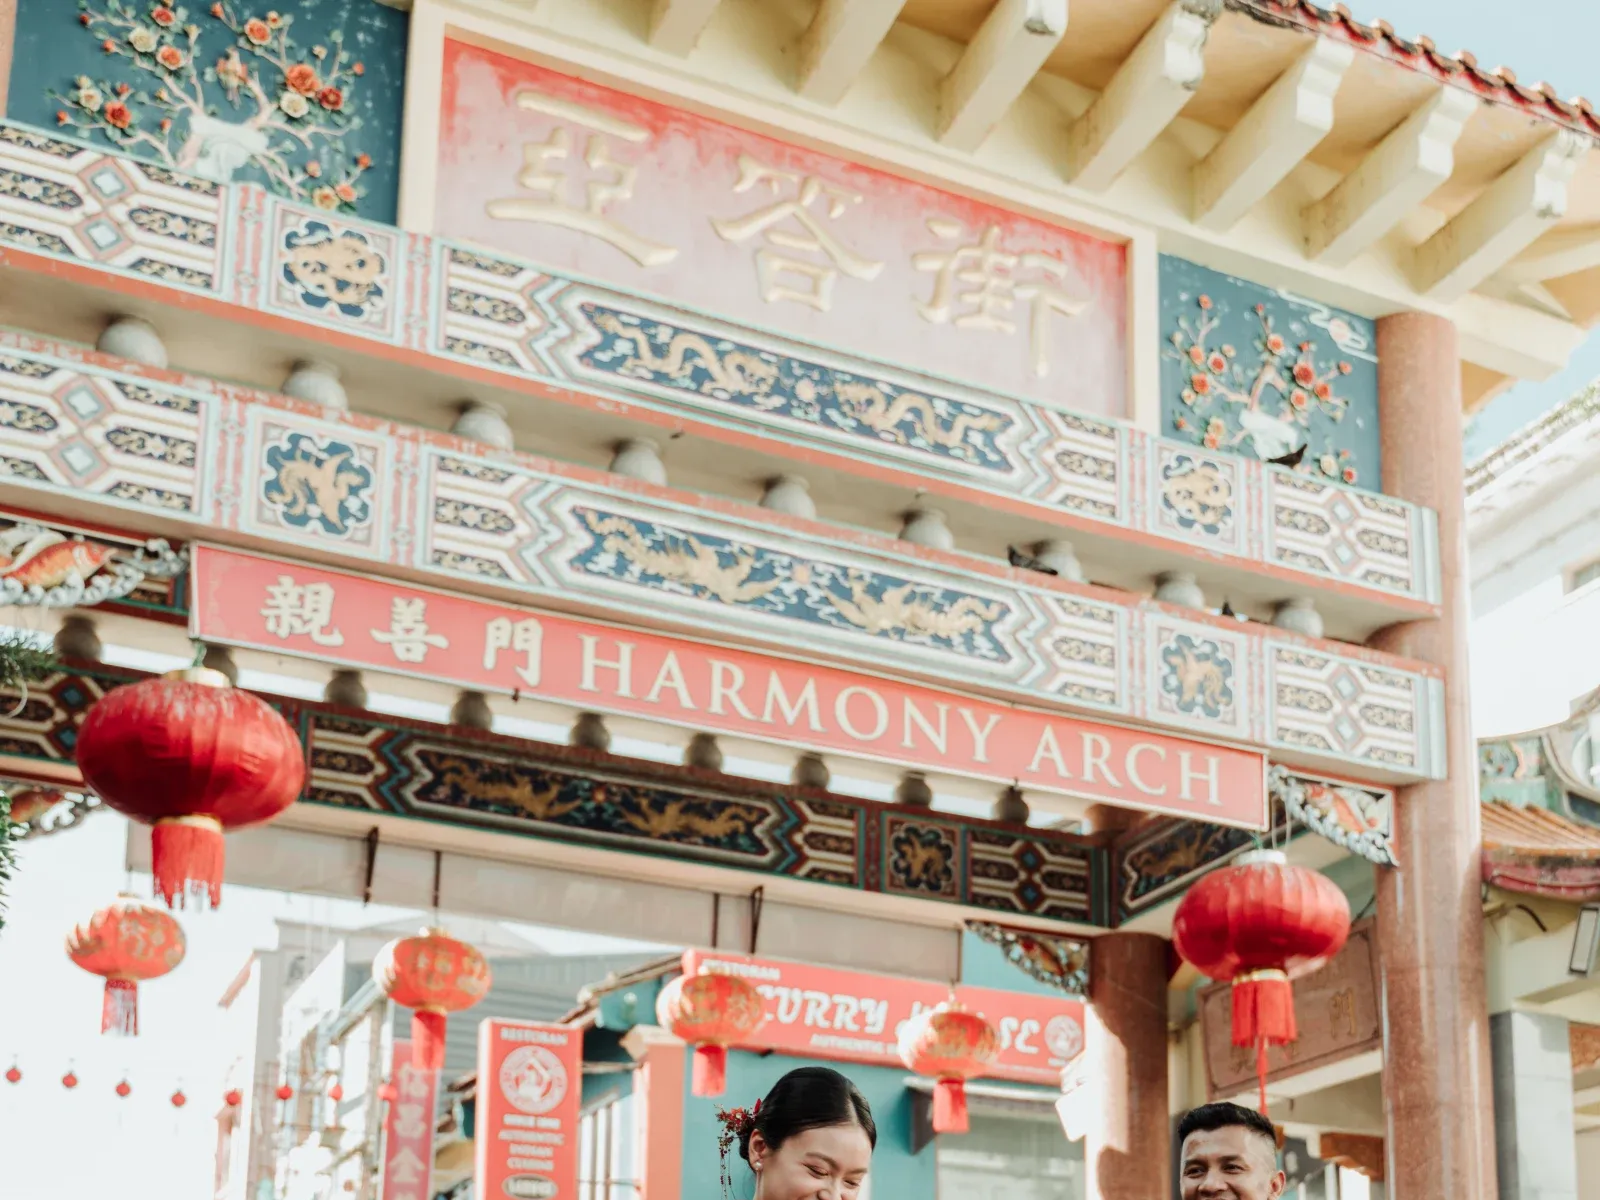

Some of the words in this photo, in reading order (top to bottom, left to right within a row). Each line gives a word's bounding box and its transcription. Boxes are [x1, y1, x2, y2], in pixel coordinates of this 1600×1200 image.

[259, 574, 544, 688] 親善門
[577, 633, 1003, 764] HARMONY
[1025, 723, 1224, 807] ARCH
